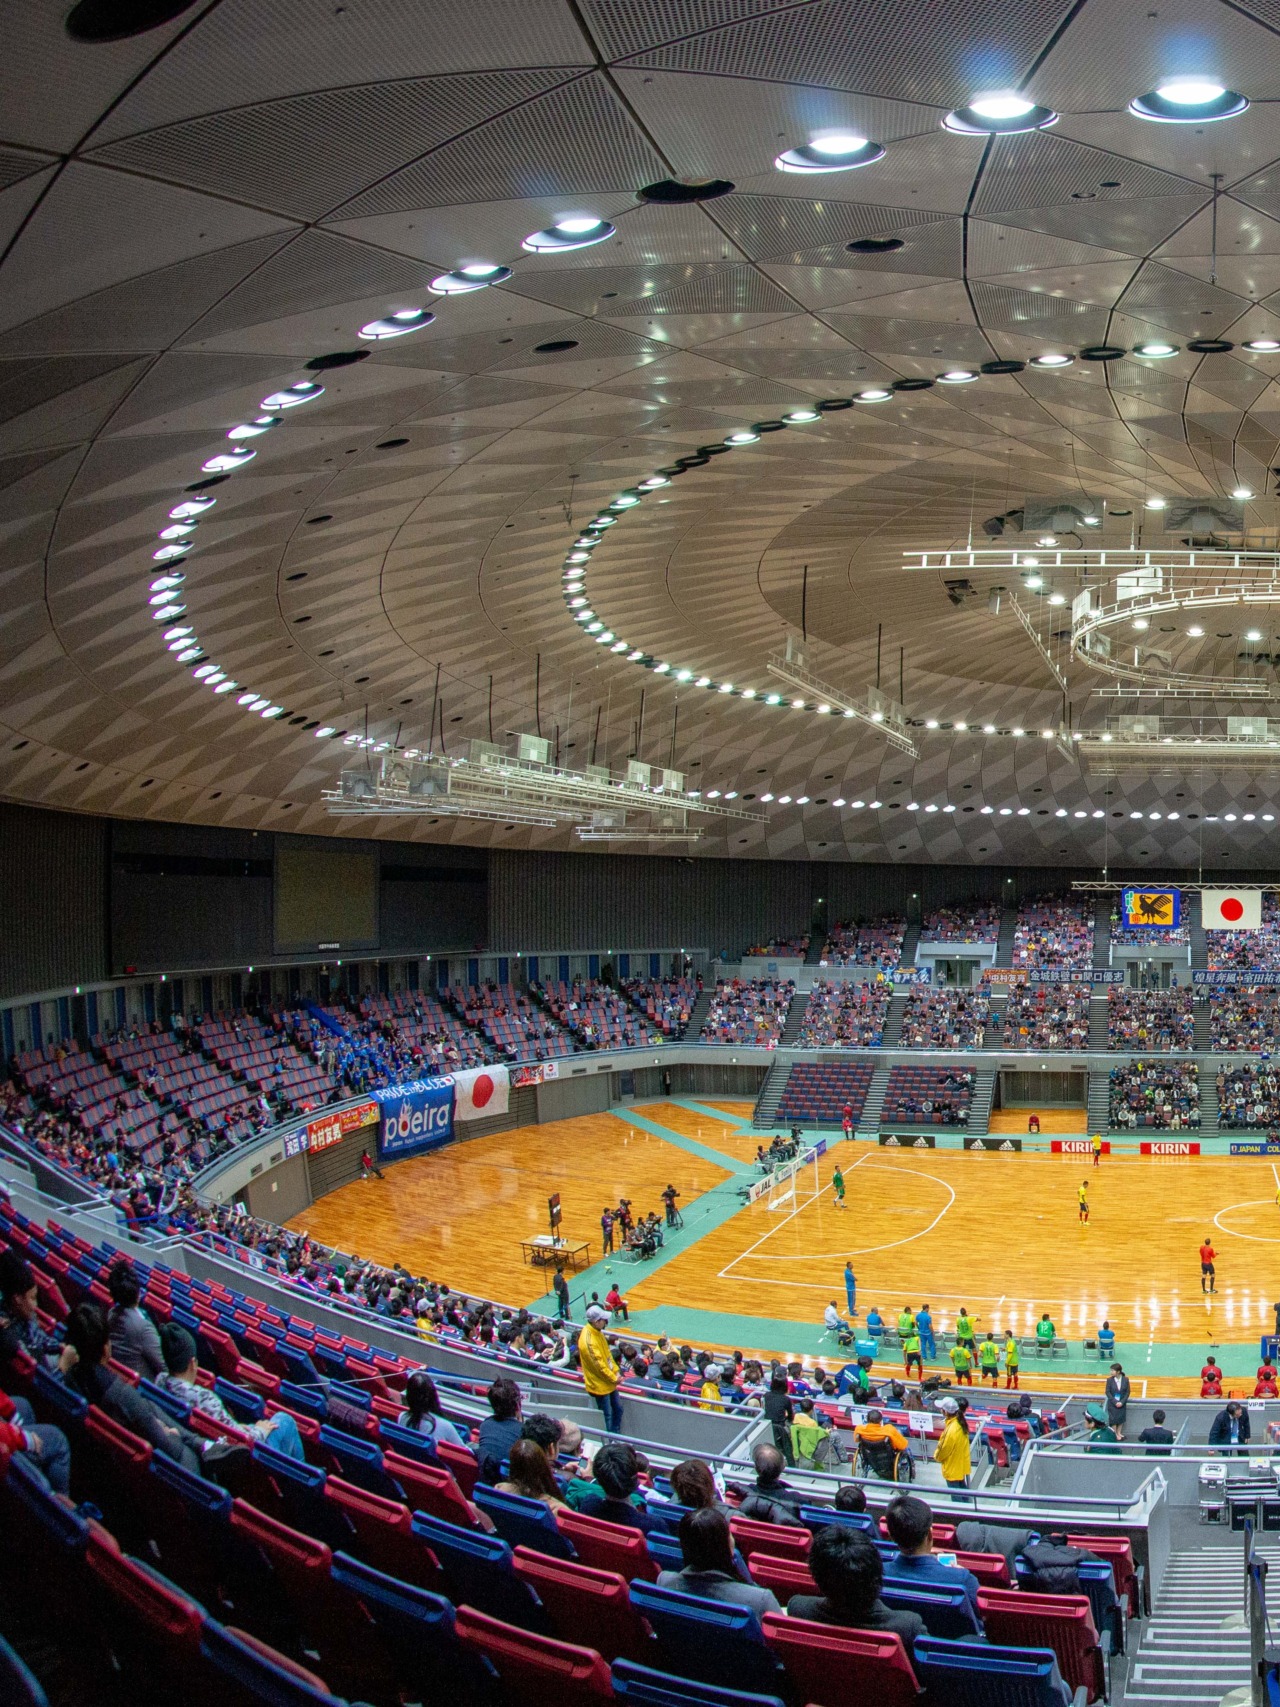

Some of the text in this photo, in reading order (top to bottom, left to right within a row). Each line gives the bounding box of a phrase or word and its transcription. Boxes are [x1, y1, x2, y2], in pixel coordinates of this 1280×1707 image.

[1030, 970, 1071, 982] 金城鉄壁
[376, 1085, 410, 1101] PRIDE
[413, 1078, 446, 1093] BLUE
[384, 1103, 450, 1147] poeira
[1151, 1143, 1190, 1154] KIRIN
[1238, 1145, 1260, 1153] JAPAN
[760, 1179, 772, 1194] JAL
